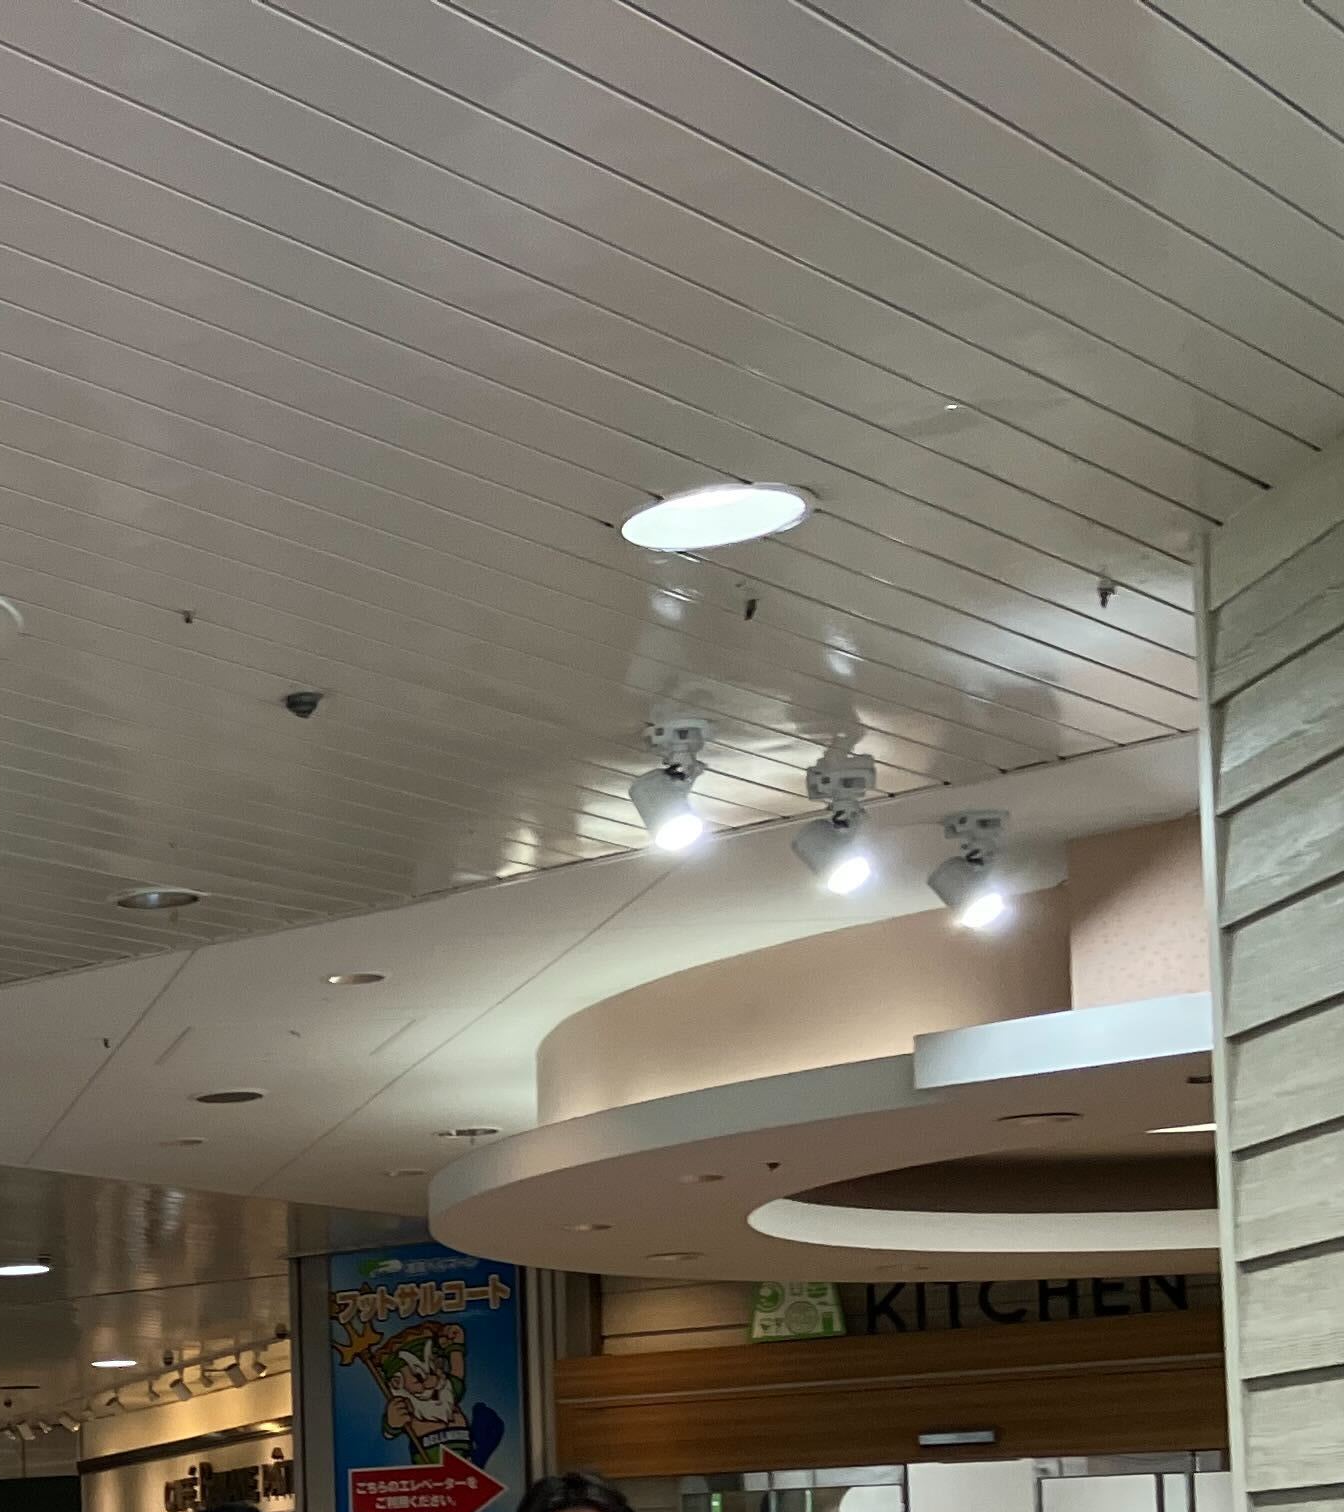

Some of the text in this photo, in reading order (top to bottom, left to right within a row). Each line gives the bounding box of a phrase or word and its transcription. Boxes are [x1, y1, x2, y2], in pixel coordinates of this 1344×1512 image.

[335, 1274, 510, 1325] フットサルコート
[865, 1275, 1190, 1333] KITCHEN
